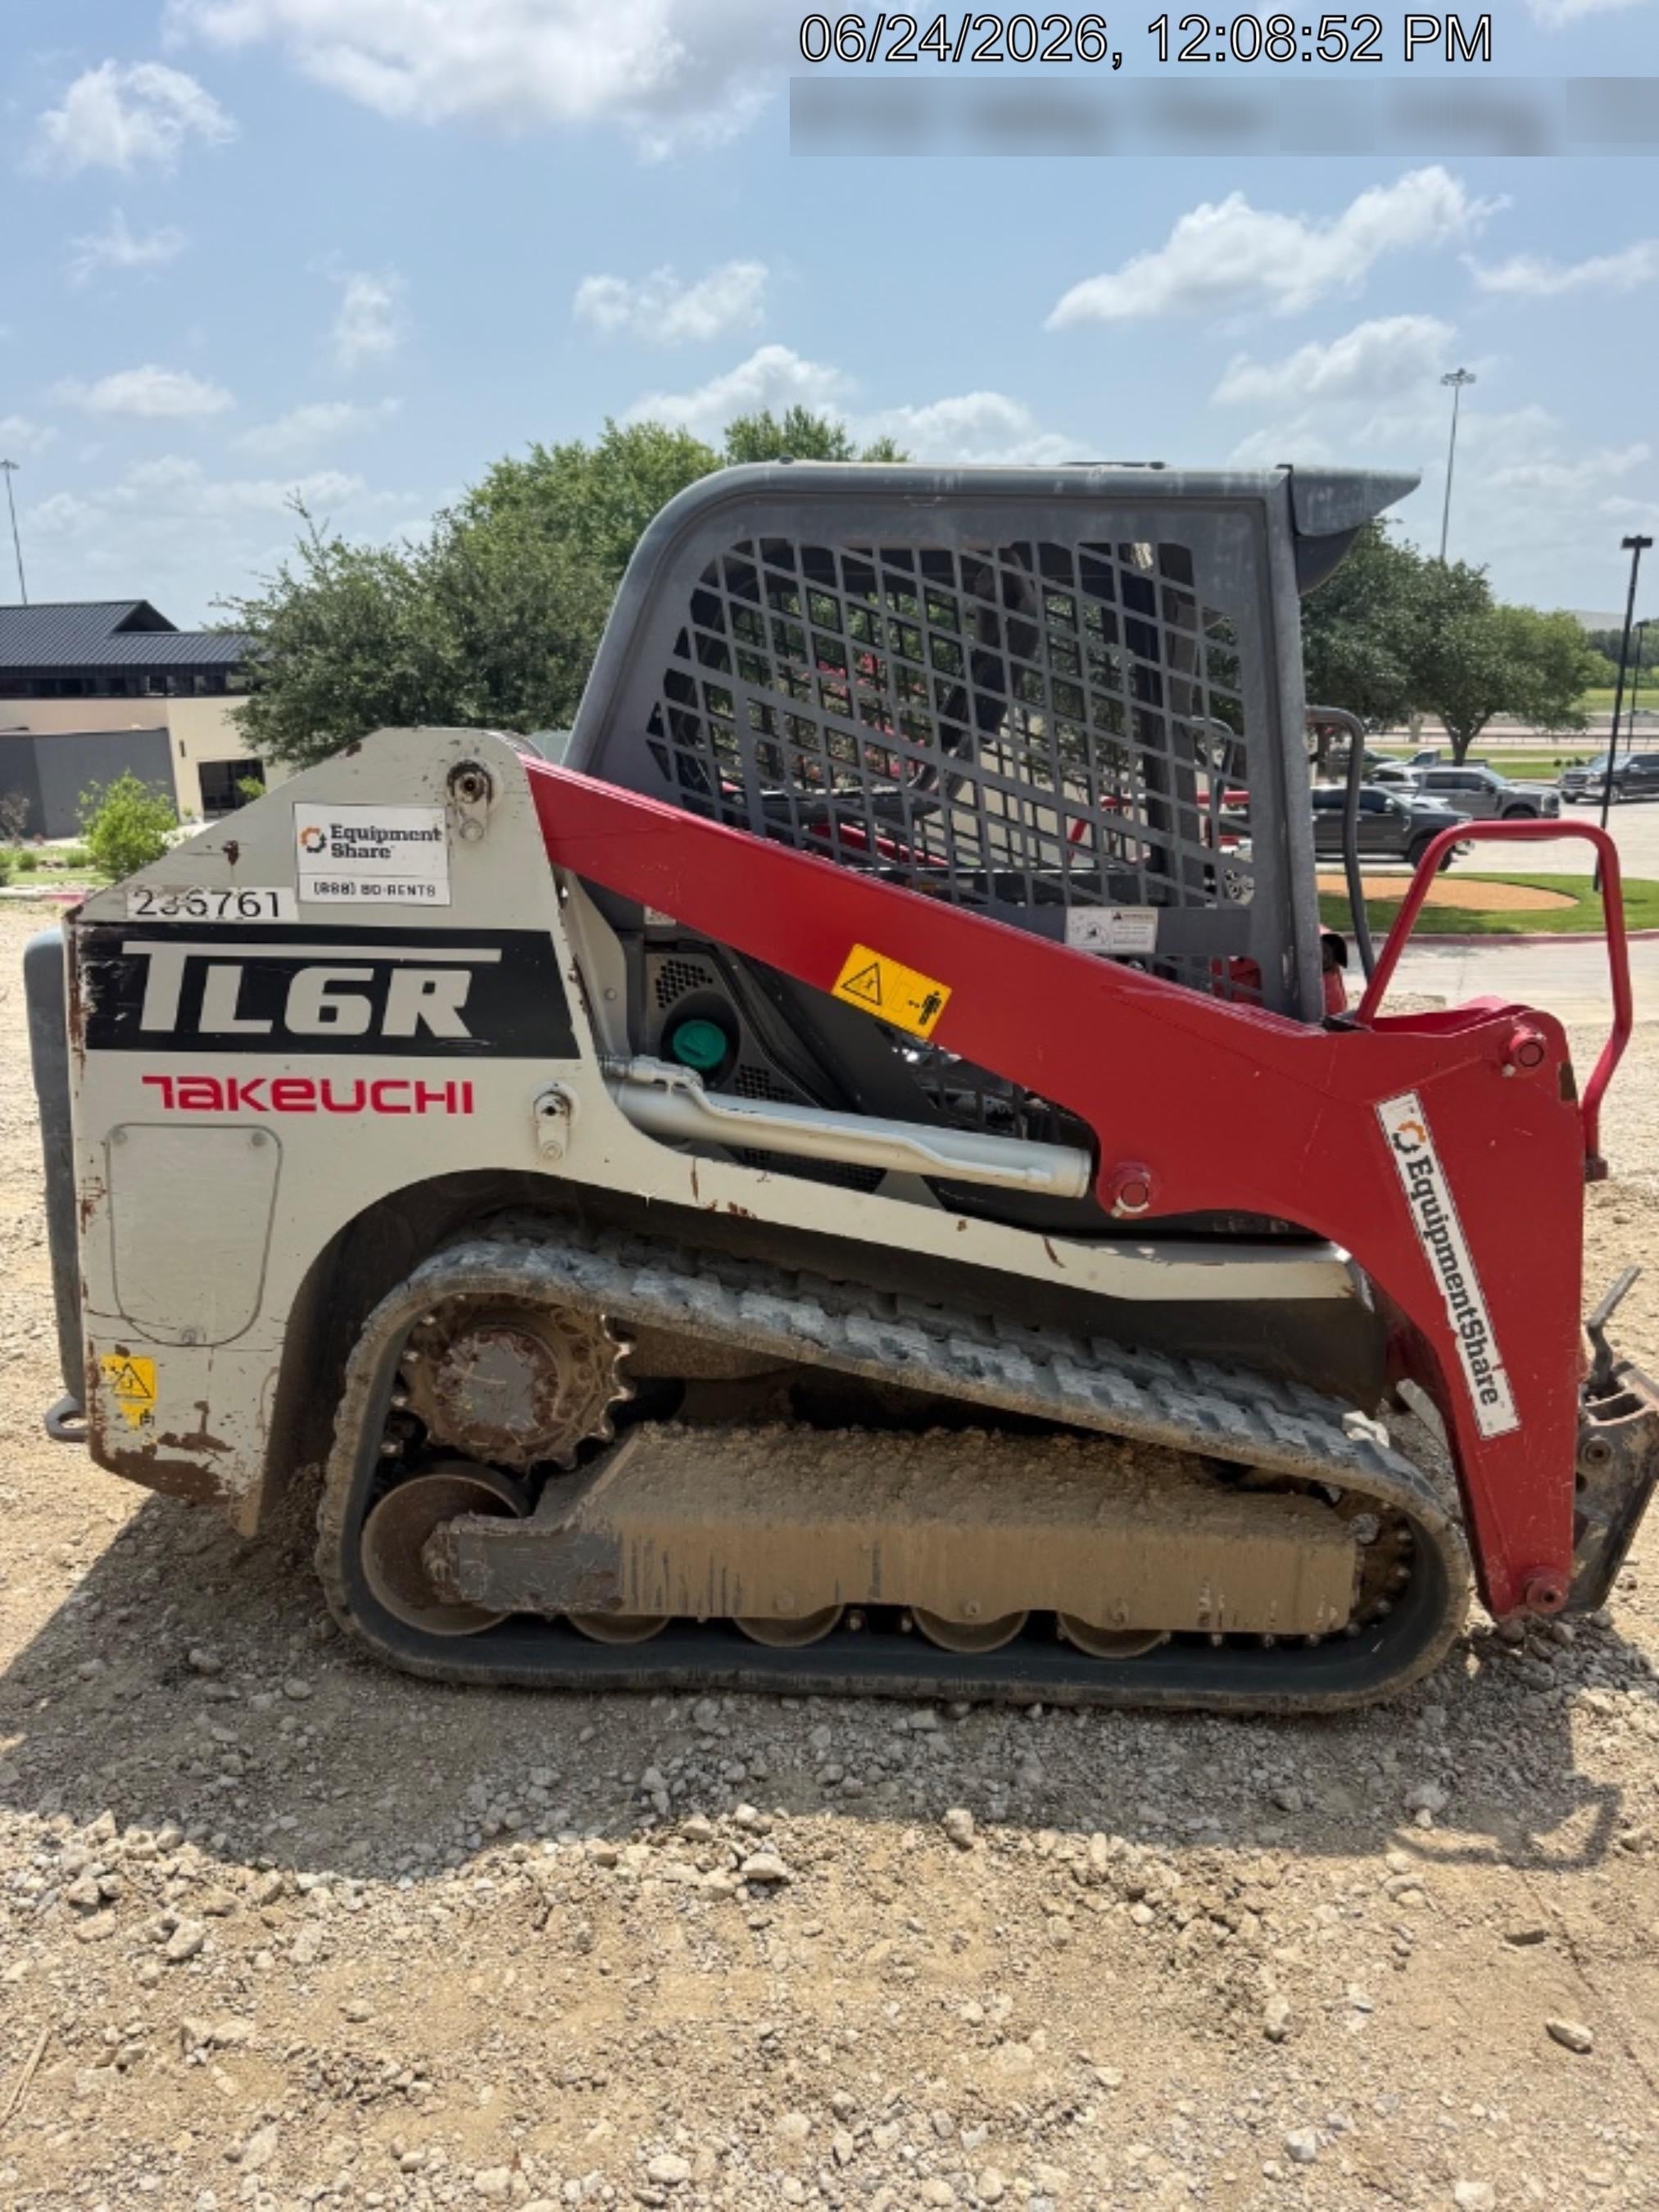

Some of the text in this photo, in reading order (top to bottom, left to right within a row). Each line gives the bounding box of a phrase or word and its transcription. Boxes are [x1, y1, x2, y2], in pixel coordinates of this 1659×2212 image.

[330, 823, 443, 844] Equipment
[331, 843, 392, 859] Share
[122, 941, 502, 1039] TL6R
[1406, 1154, 1498, 1407] EquipmentShare
